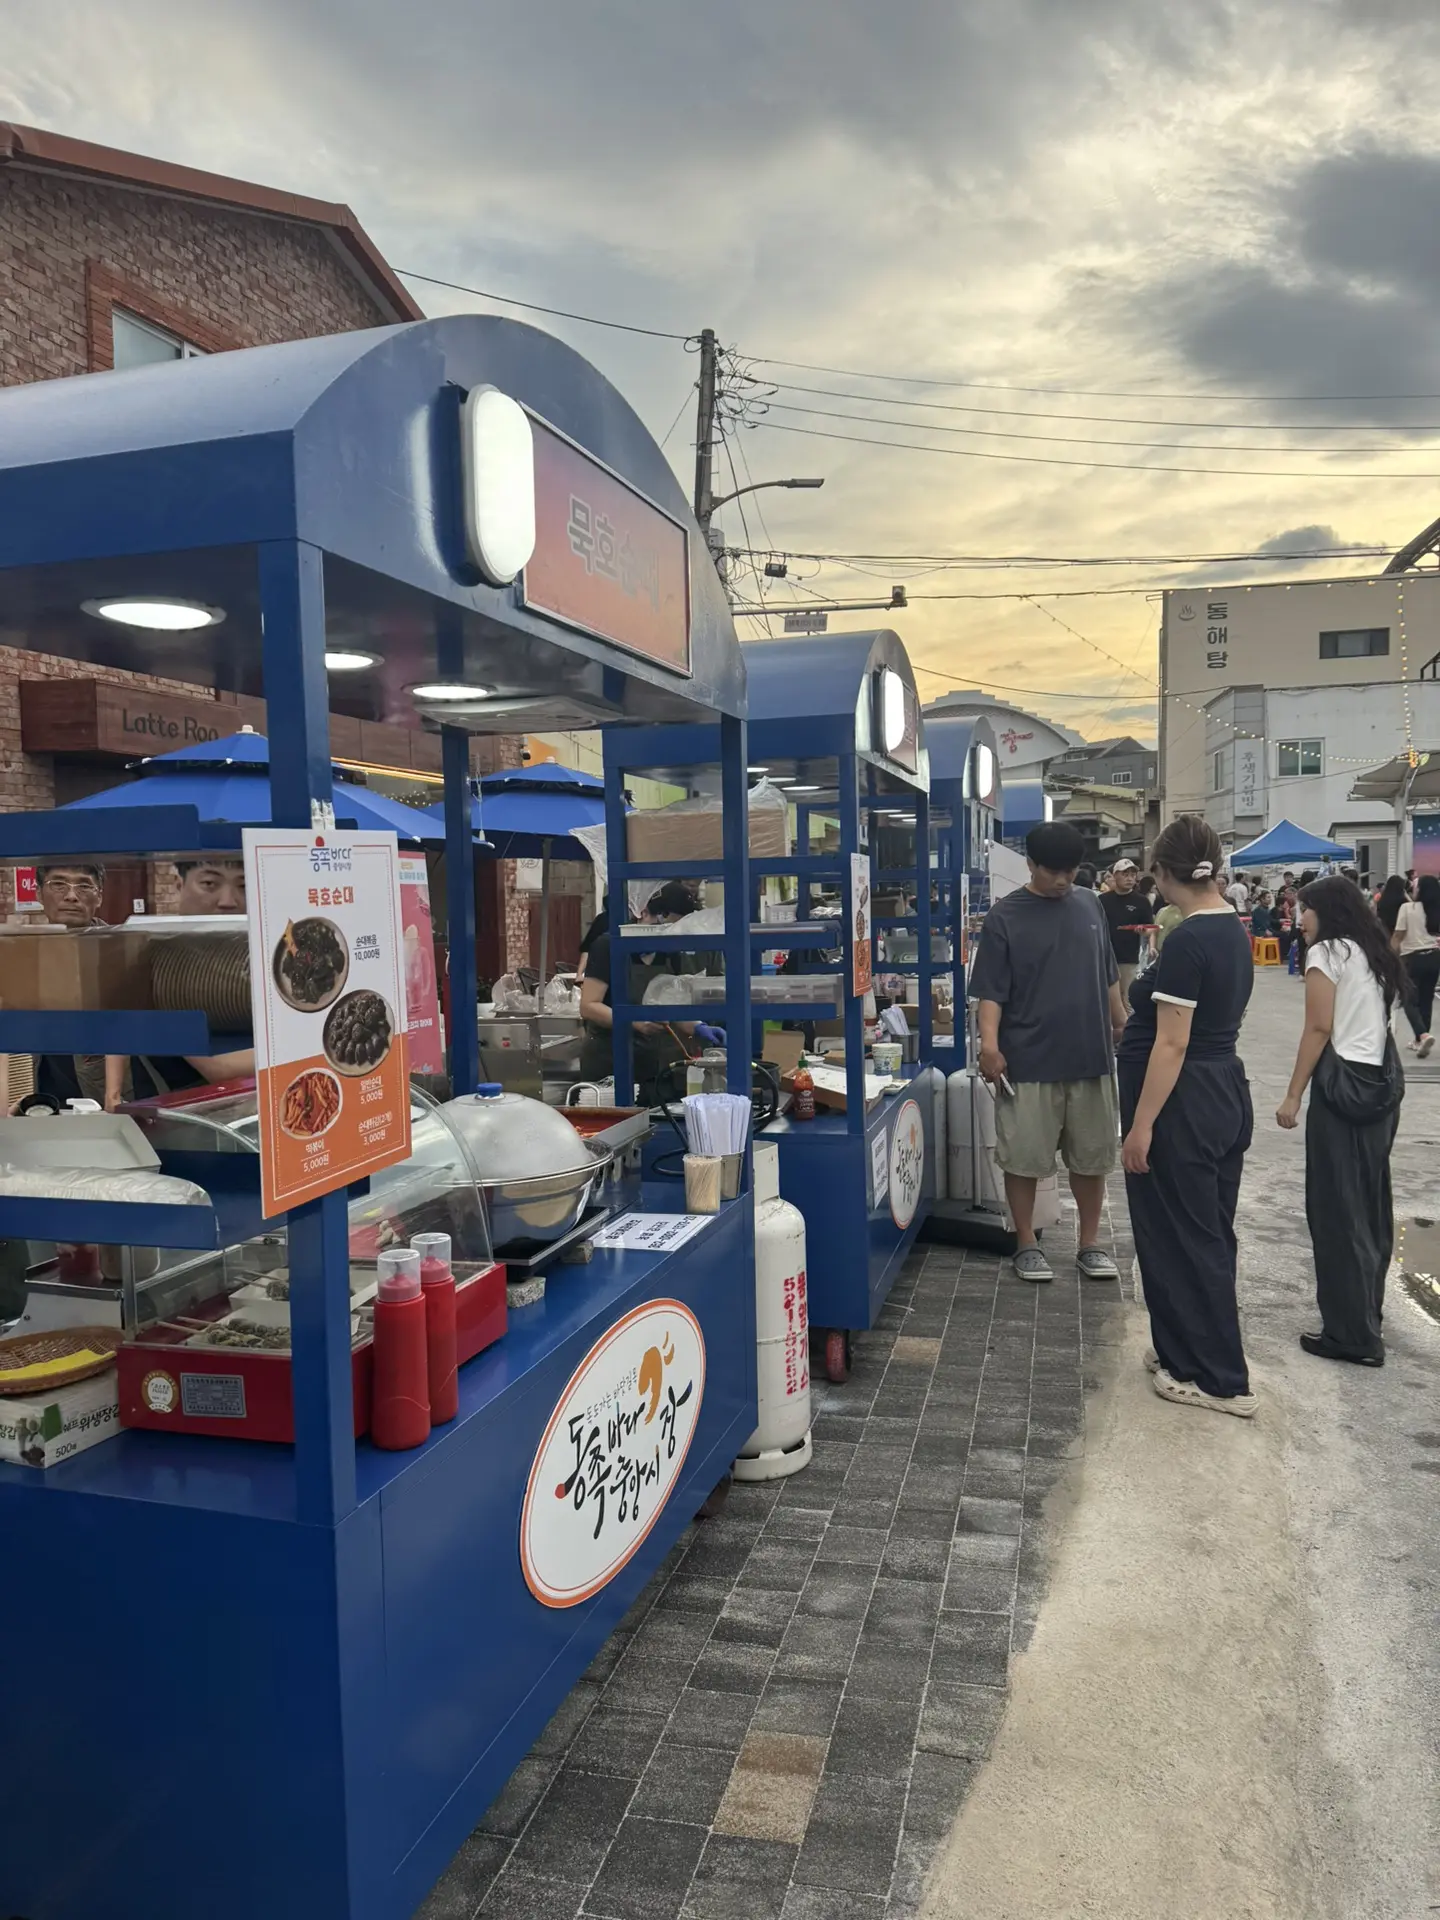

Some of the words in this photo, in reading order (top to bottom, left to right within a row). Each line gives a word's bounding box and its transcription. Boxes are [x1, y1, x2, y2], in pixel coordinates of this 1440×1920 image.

[1207, 602, 1229, 669] 동해탕
[123, 708, 179, 738] Latte
[308, 886, 354, 906] 묵호순대
[354, 948, 380, 961] 10,000원
[360, 1089, 383, 1104] 5,000원
[363, 1129, 386, 1146] 3,000원
[303, 1153, 329, 1173] 5,000원
[586, 1392, 612, 1424] 독도가는
